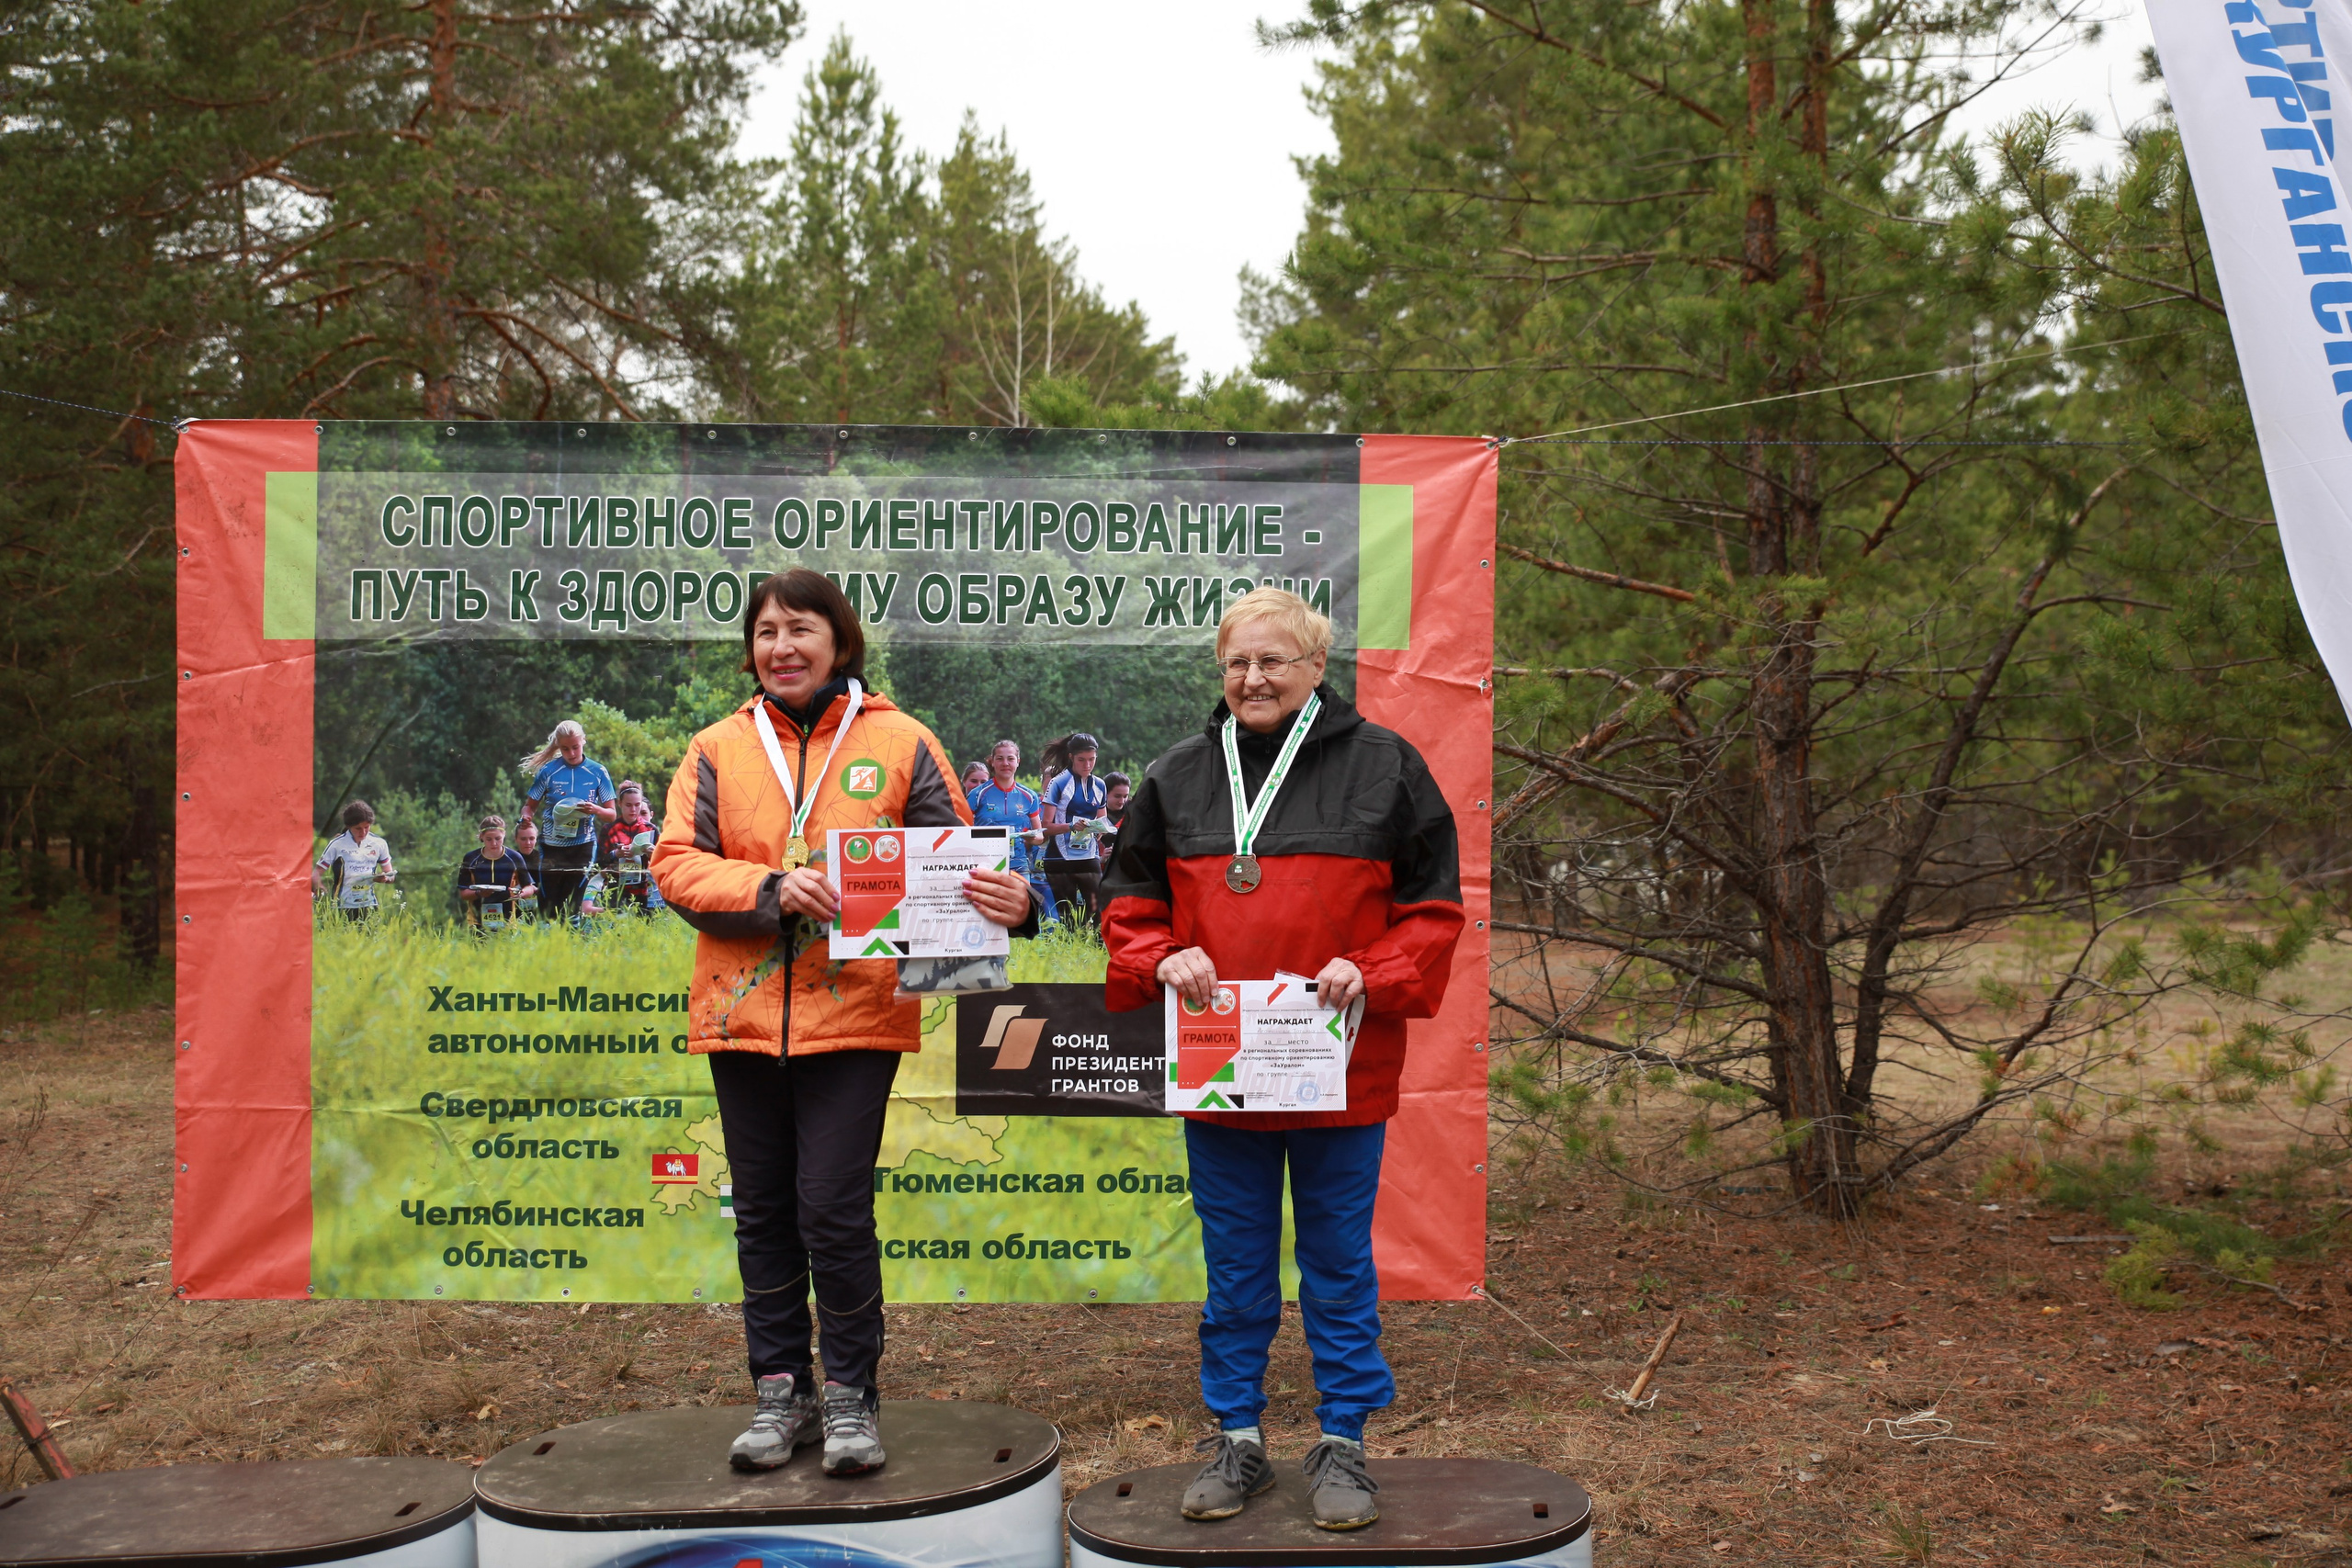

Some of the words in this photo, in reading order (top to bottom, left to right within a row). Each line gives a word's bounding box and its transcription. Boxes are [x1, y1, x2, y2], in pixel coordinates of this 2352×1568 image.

[382, 494, 753, 548] СПОРТИВНОЕ
[774, 498, 1283, 555] ОРИЕНТИРОВАНИЕ
[350, 569, 489, 622] ПУТЬ
[510, 569, 540, 622] К
[558, 570, 899, 631] ЗДОРОМУ
[917, 572, 1126, 627] ОБРАЗУ
[1144, 576, 1331, 627] ЖИИ
[847, 880, 901, 892] ГРАМОТА
[1257, 1018, 1314, 1026] НАГРАЖДАЕТ
[427, 1027, 659, 1054] автономный
[1051, 1034, 1110, 1051] ФОНД
[1183, 1032, 1237, 1044] ГРАМОТА
[1051, 1078, 1139, 1093] ГРАНТОВ
[420, 1091, 683, 1123] Свердловская
[471, 1133, 620, 1159] область
[875, 1167, 1084, 1193] Тюменская
[401, 1200, 644, 1227] Челябинская
[443, 1241, 588, 1269] область
[877, 1238, 969, 1259] ская
[982, 1233, 1131, 1259] область
